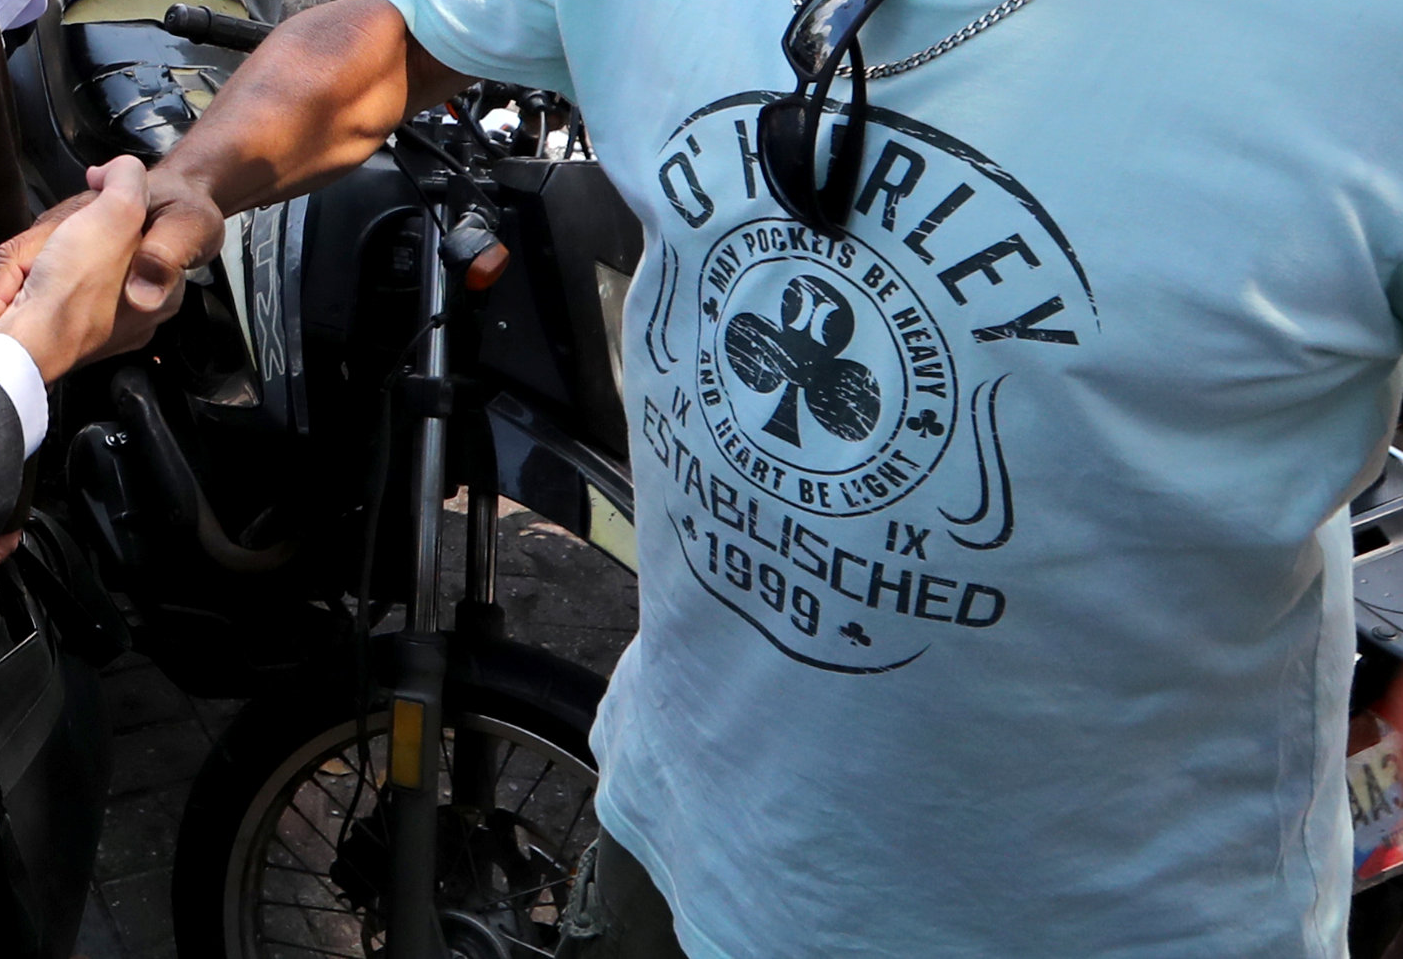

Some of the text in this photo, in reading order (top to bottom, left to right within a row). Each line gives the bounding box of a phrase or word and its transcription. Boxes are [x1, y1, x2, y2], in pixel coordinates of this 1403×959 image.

[659, 119, 1080, 345] O'HRLEY
[708, 227, 947, 399] MAY POCKETS BE HEAVY
[672, 386, 692, 428] IX
[700, 349, 921, 509] AND HEART BE LIGHT
[643, 395, 1007, 628] ESTABLISCHED
[705, 531, 821, 638] 1999
[885, 520, 932, 561] IX
